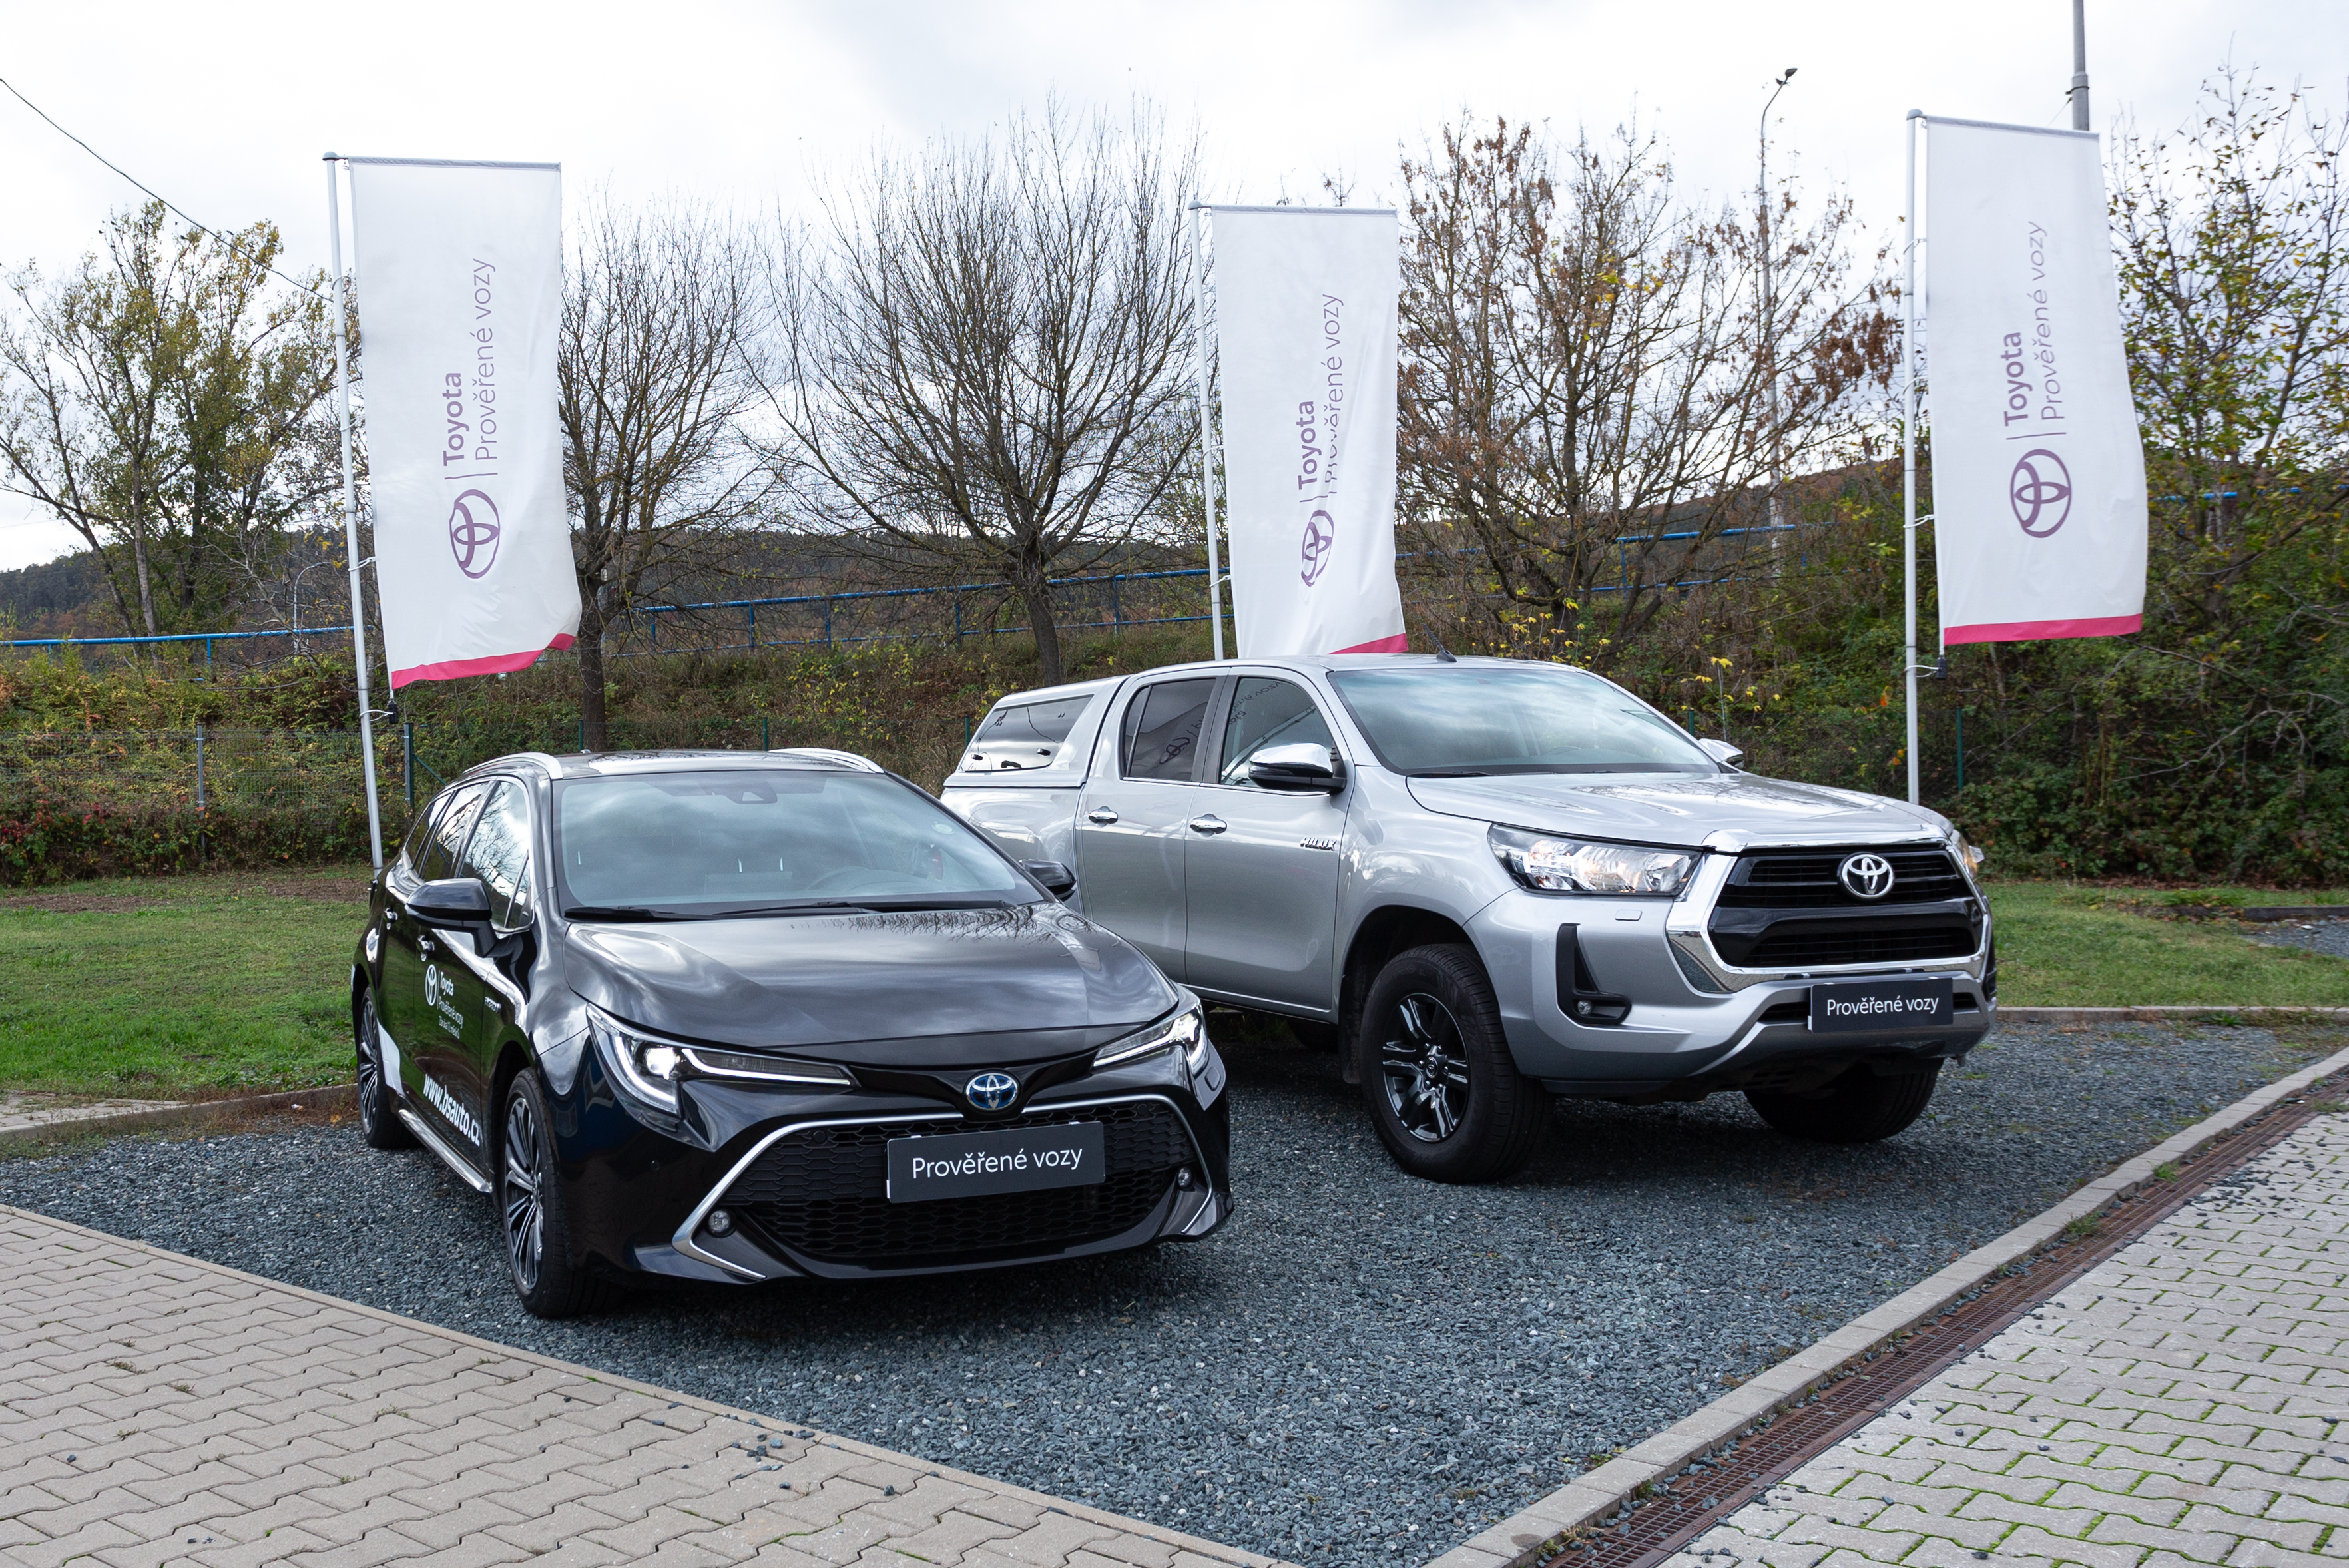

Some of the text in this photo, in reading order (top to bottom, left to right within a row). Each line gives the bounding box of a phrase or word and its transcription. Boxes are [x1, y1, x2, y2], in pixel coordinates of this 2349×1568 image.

[1322, 294, 1344, 350] vozy
[2027, 221, 2065, 421] Prověřené vozy
[469, 258, 498, 461] Prověřené vozy
[2000, 332, 2033, 427] Toyota
[442, 372, 470, 467] Toyota
[1296, 400, 1322, 491] Toyota
[1300, 836, 1338, 851] HILUX
[440, 971, 454, 996] Toyota
[1827, 995, 1940, 1016] Prověřené vozy
[423, 1073, 480, 1147] www.bsauto.cz
[912, 1147, 1083, 1179] Prověřené vozy
